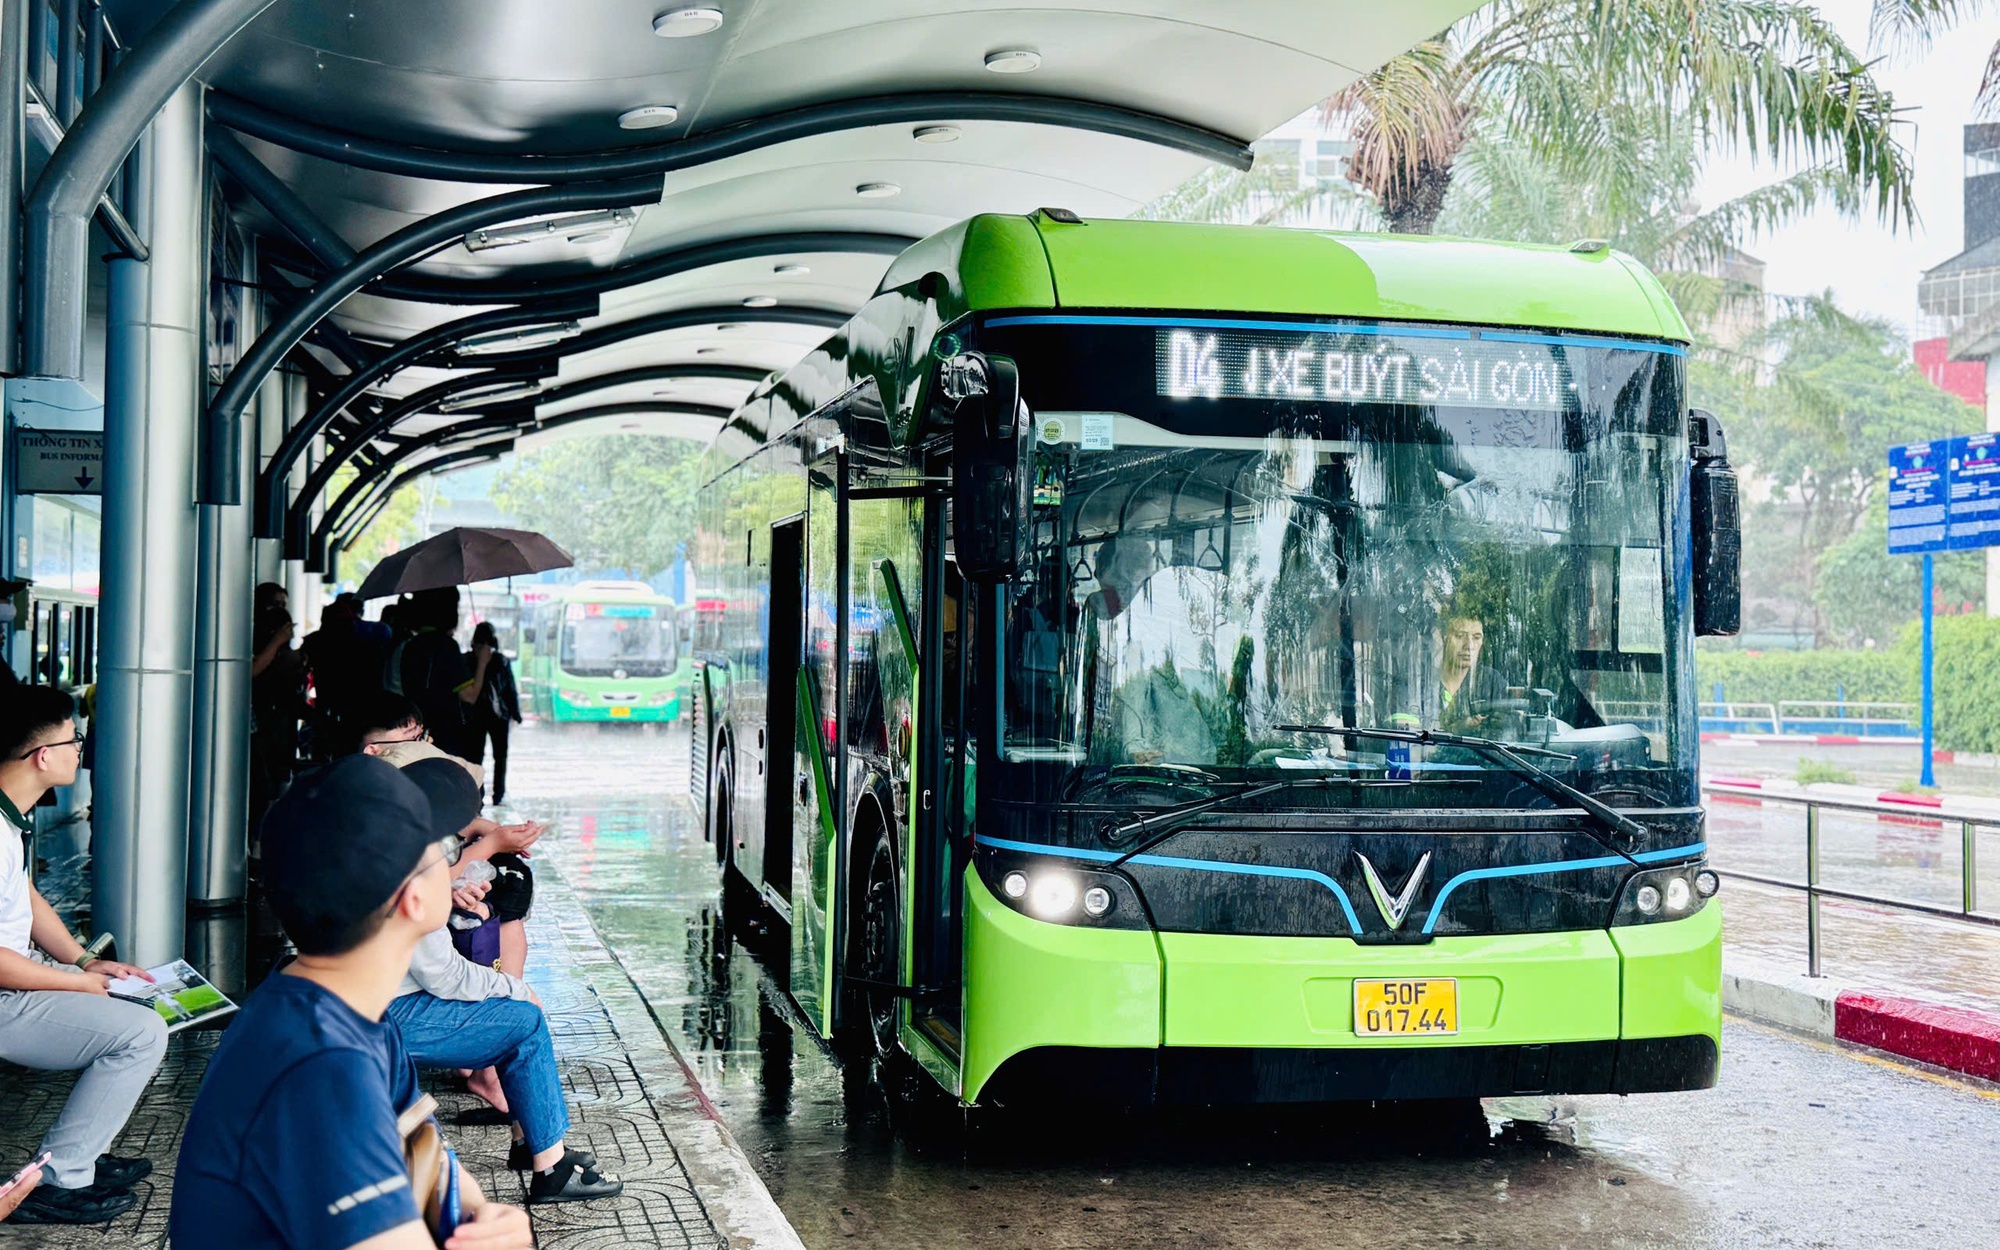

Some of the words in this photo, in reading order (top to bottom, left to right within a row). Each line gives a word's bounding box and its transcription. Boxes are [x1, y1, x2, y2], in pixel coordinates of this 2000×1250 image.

[1170, 331, 1221, 399] D4
[1324, 343, 1410, 399] BUÝT
[1420, 346, 1480, 401] SÀI
[1491, 350, 1558, 403] GÒN
[69, 437, 92, 449] TIN
[40, 452, 58, 460] BUS
[1383, 982, 1427, 1006] 50F
[1367, 1008, 1447, 1032] 017.44
